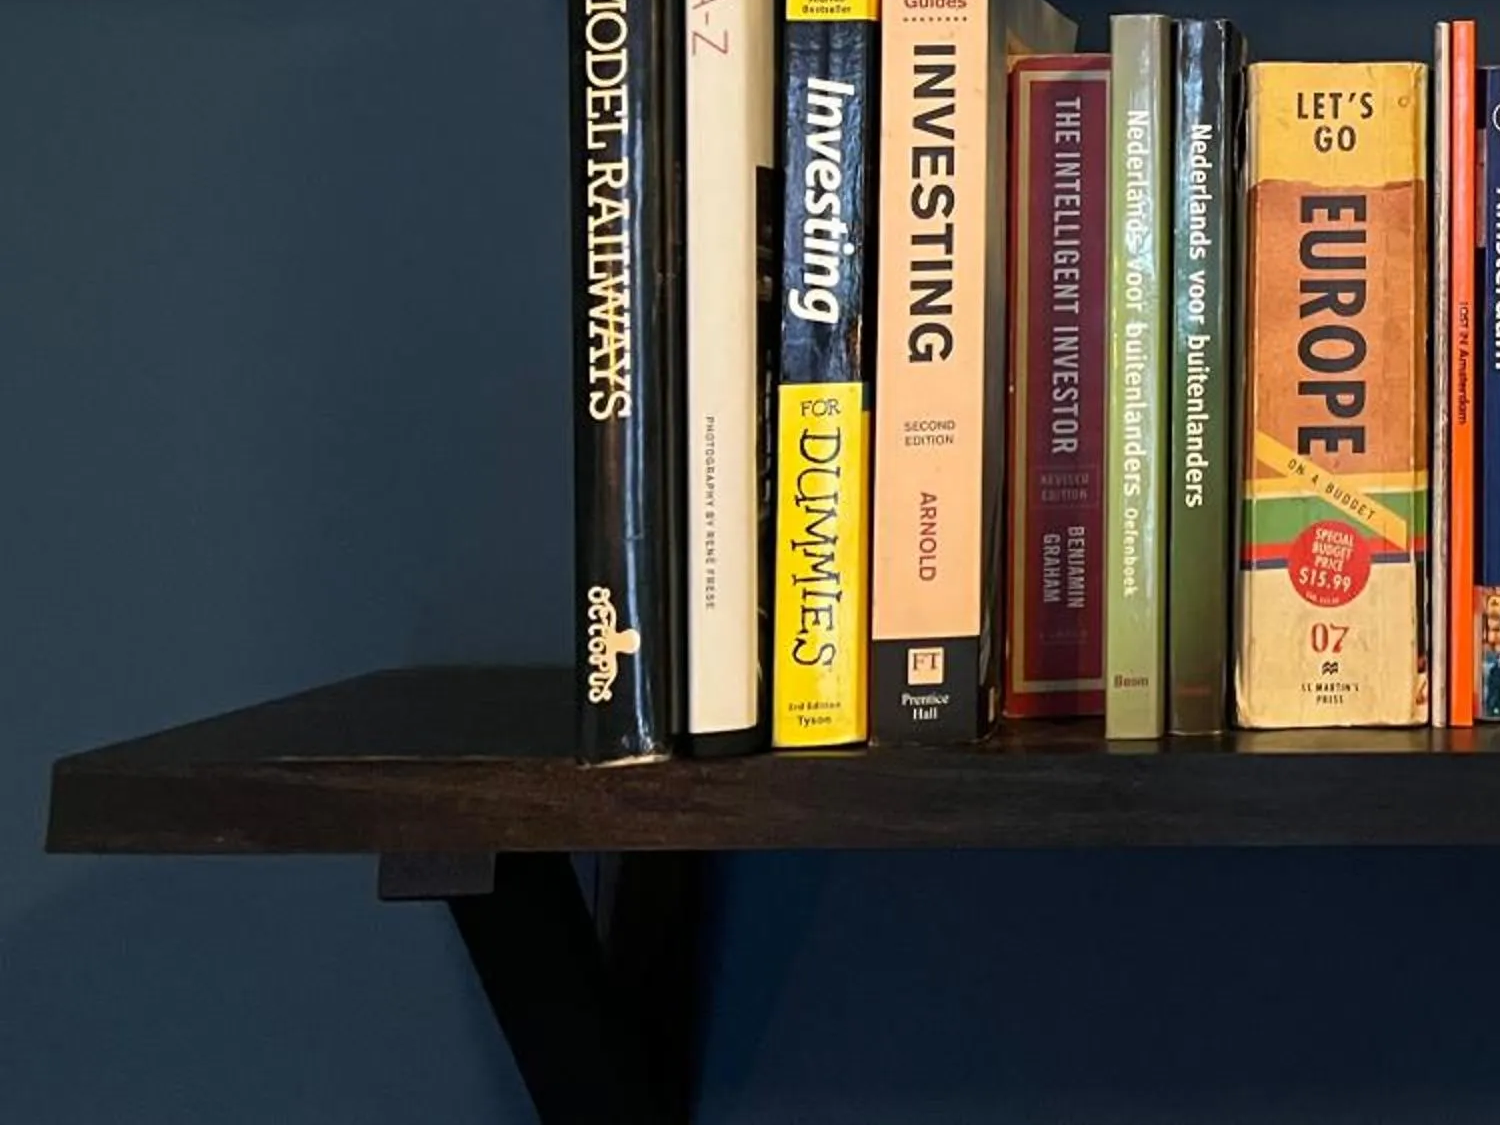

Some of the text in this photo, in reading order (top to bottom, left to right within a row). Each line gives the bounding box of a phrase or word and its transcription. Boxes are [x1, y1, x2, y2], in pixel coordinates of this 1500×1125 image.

[1296, 92, 1374, 120] LET'S
[1313, 125, 1357, 153] GO
[788, 77, 855, 325] Investing
[907, 44, 957, 365] INVESTING
[1124, 110, 1152, 250] Nederlands
[587, 158, 632, 420] RAILWAYS
[1051, 96, 1081, 454] THE INTELLIGENT INVESTOR
[1124, 260, 1145, 312] voor
[1185, 124, 1213, 509] Nederlands voor buitenlanders
[1297, 194, 1368, 456] EUROPE
[1123, 323, 1149, 496] buitenlanders
[1457, 348, 1471, 426] Amsterdam
[904, 420, 956, 432] SECOND
[904, 433, 955, 447] EDITION
[704, 416, 716, 508] PHOTOGRAPHY
[1287, 458, 1306, 476] ON
[1324, 481, 1378, 521] BUDGET
[705, 511, 716, 528] BY
[791, 398, 842, 668] FOR DUMMIES
[918, 491, 938, 583] ARNOLD
[1314, 527, 1354, 547] SPECIAL
[1042, 533, 1061, 604] GRAHAM
[1067, 526, 1085, 609] BENJAMIN
[1311, 540, 1354, 560] BUDGET
[1314, 555, 1344, 572] PRICE
[1298, 566, 1352, 593] $15.99
[912, 652, 941, 671] FT
[1310, 622, 1350, 654] 07
[797, 715, 832, 727] Tyson
[901, 692, 950, 707] Prentice
[913, 707, 938, 721] Hall
